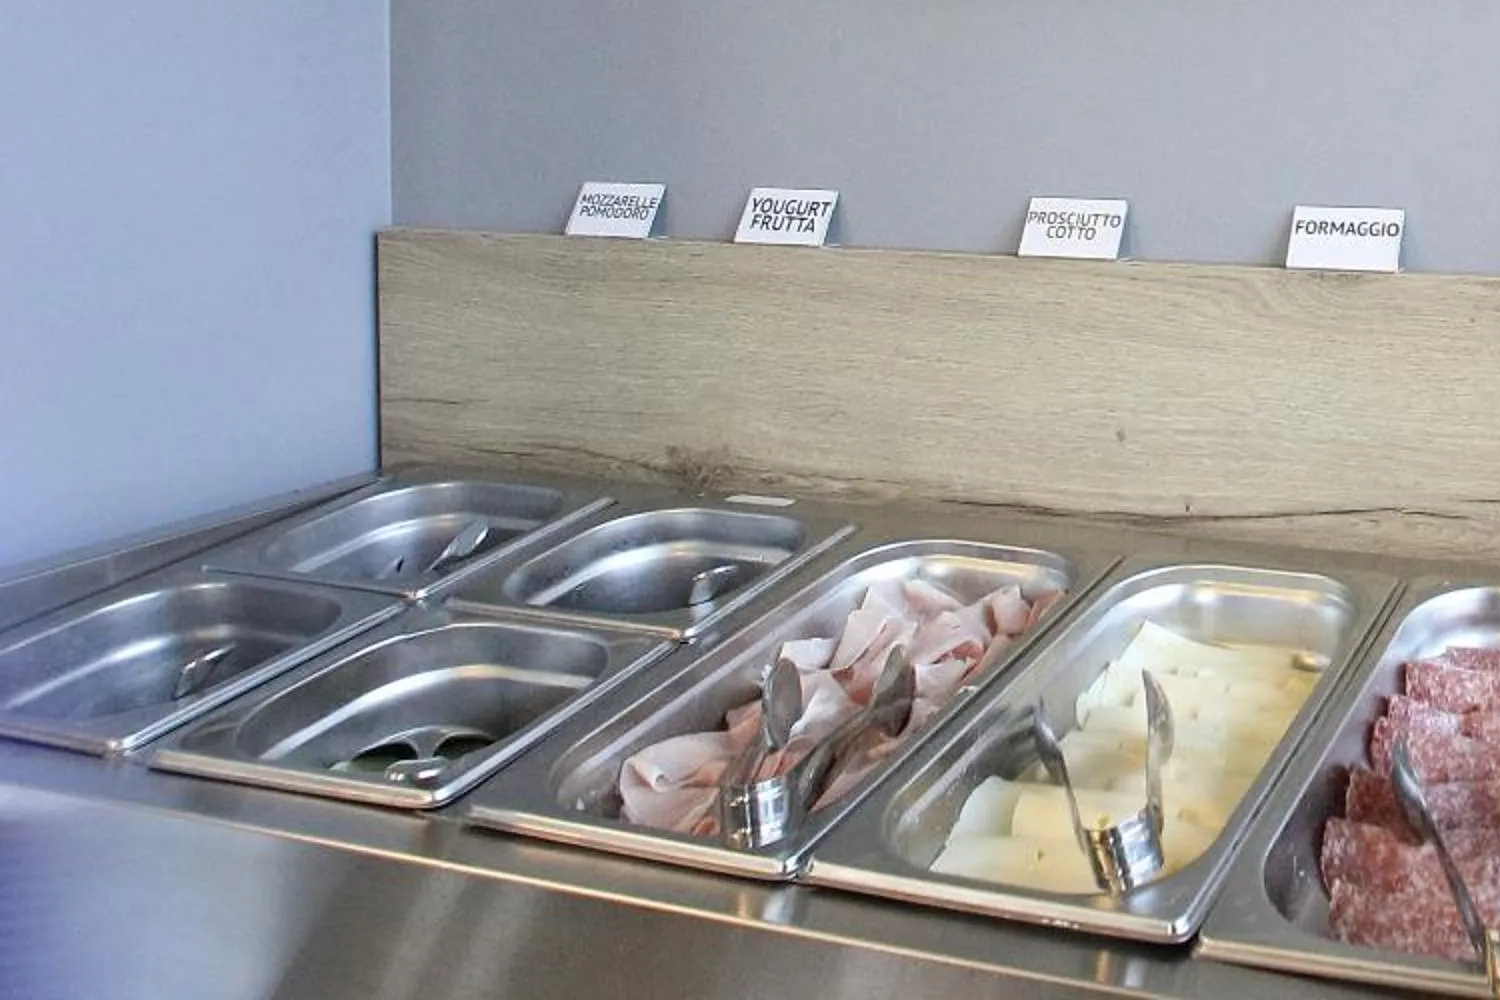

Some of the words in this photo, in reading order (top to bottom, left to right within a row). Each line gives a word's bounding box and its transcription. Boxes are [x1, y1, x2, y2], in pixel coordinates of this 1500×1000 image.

[580, 194, 658, 208] MOZZARELLE
[752, 198, 832, 216] YOUGURT
[579, 205, 649, 220] POMODORO
[1028, 211, 1121, 228] PROSCIUTTO
[750, 214, 815, 232] FRUTTA
[1295, 220, 1400, 236] FORMAGGIO
[1047, 226, 1096, 240] COTTO
